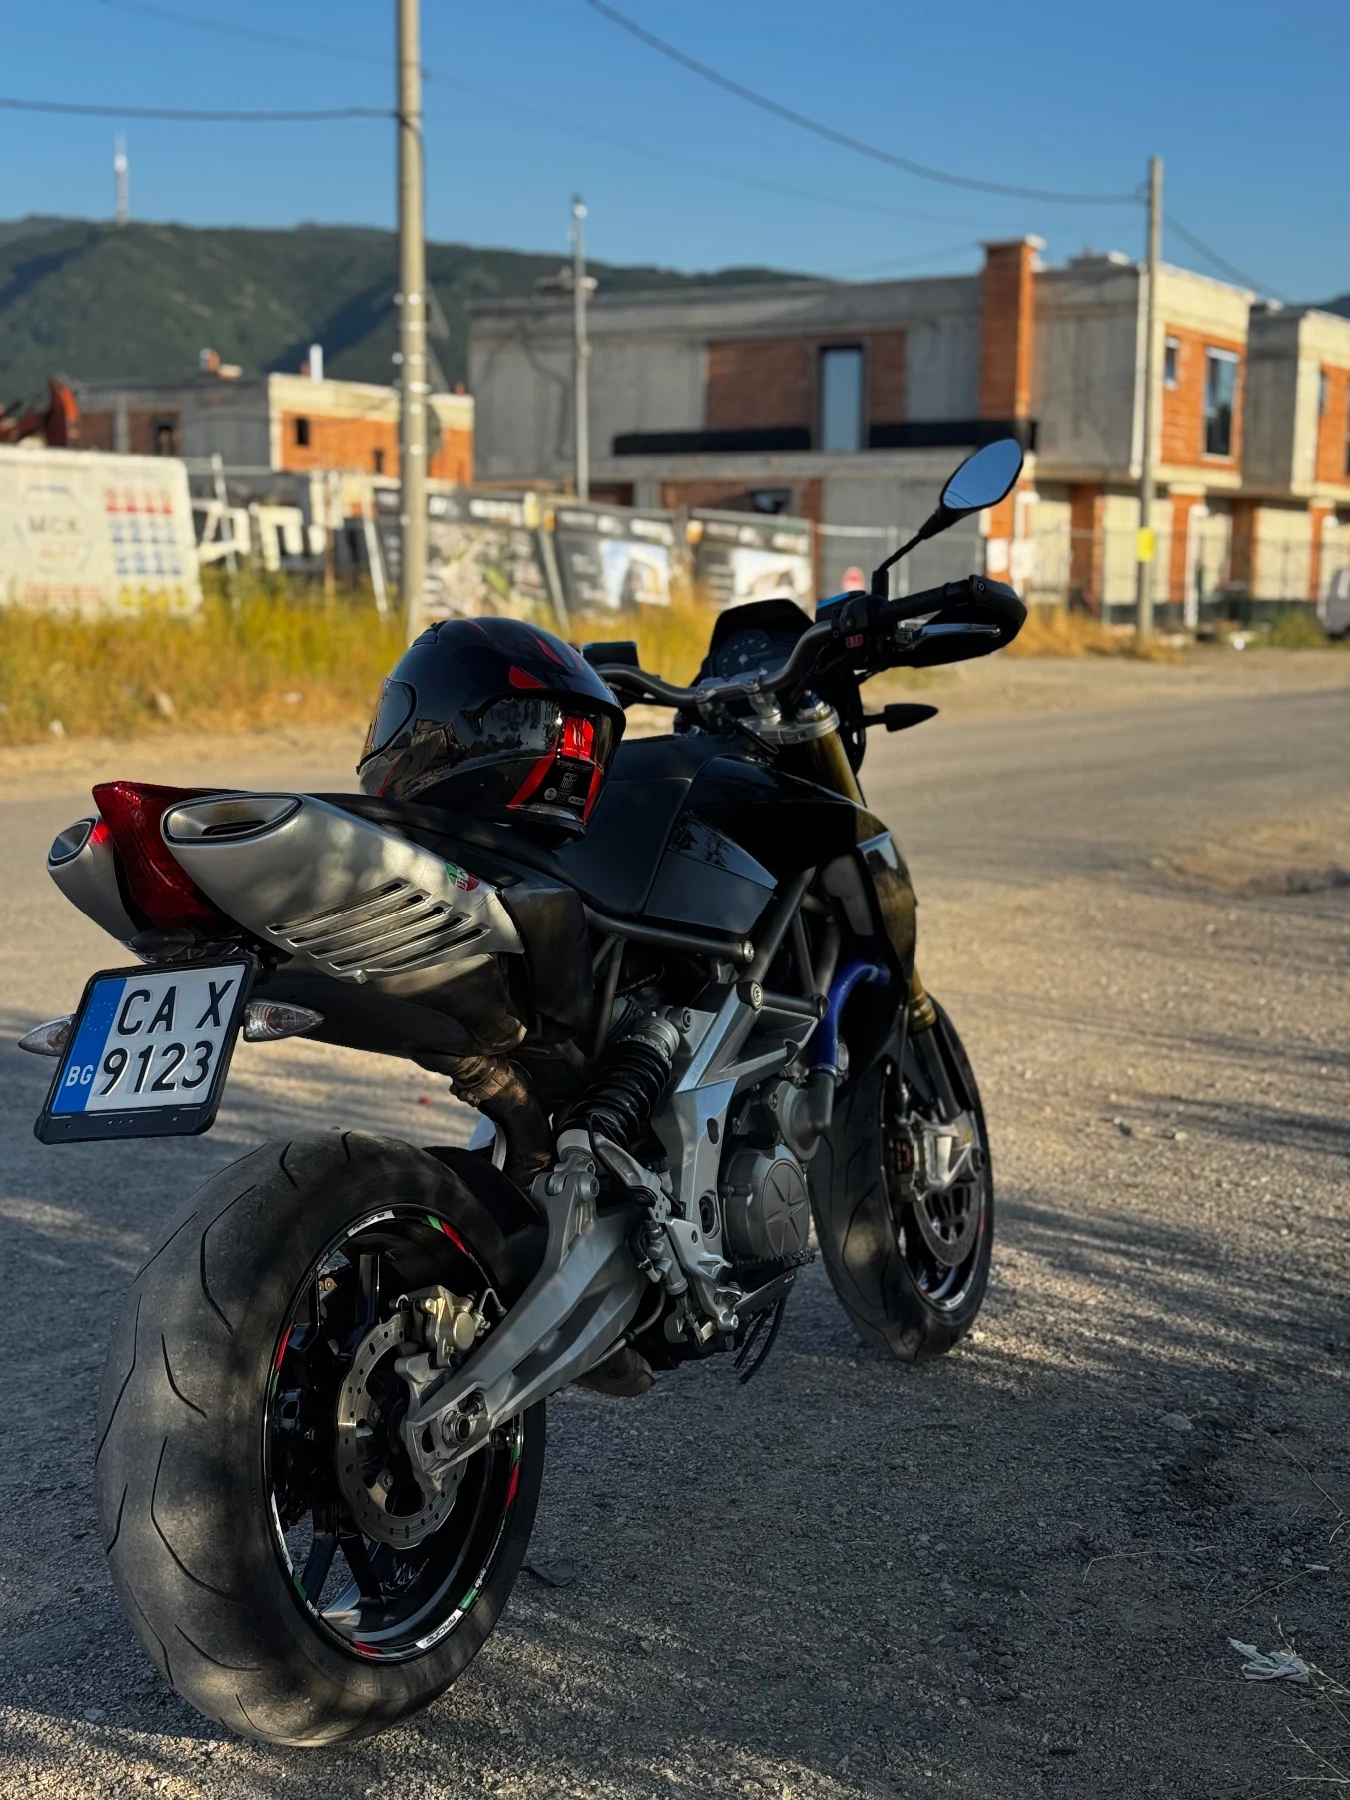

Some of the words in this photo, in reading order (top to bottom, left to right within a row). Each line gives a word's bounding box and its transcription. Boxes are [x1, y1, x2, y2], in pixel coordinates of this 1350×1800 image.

[116, 985, 178, 1036] CA
[196, 979, 235, 1029] X
[65, 1064, 94, 1087] BG
[100, 1040, 214, 1097] 9123
